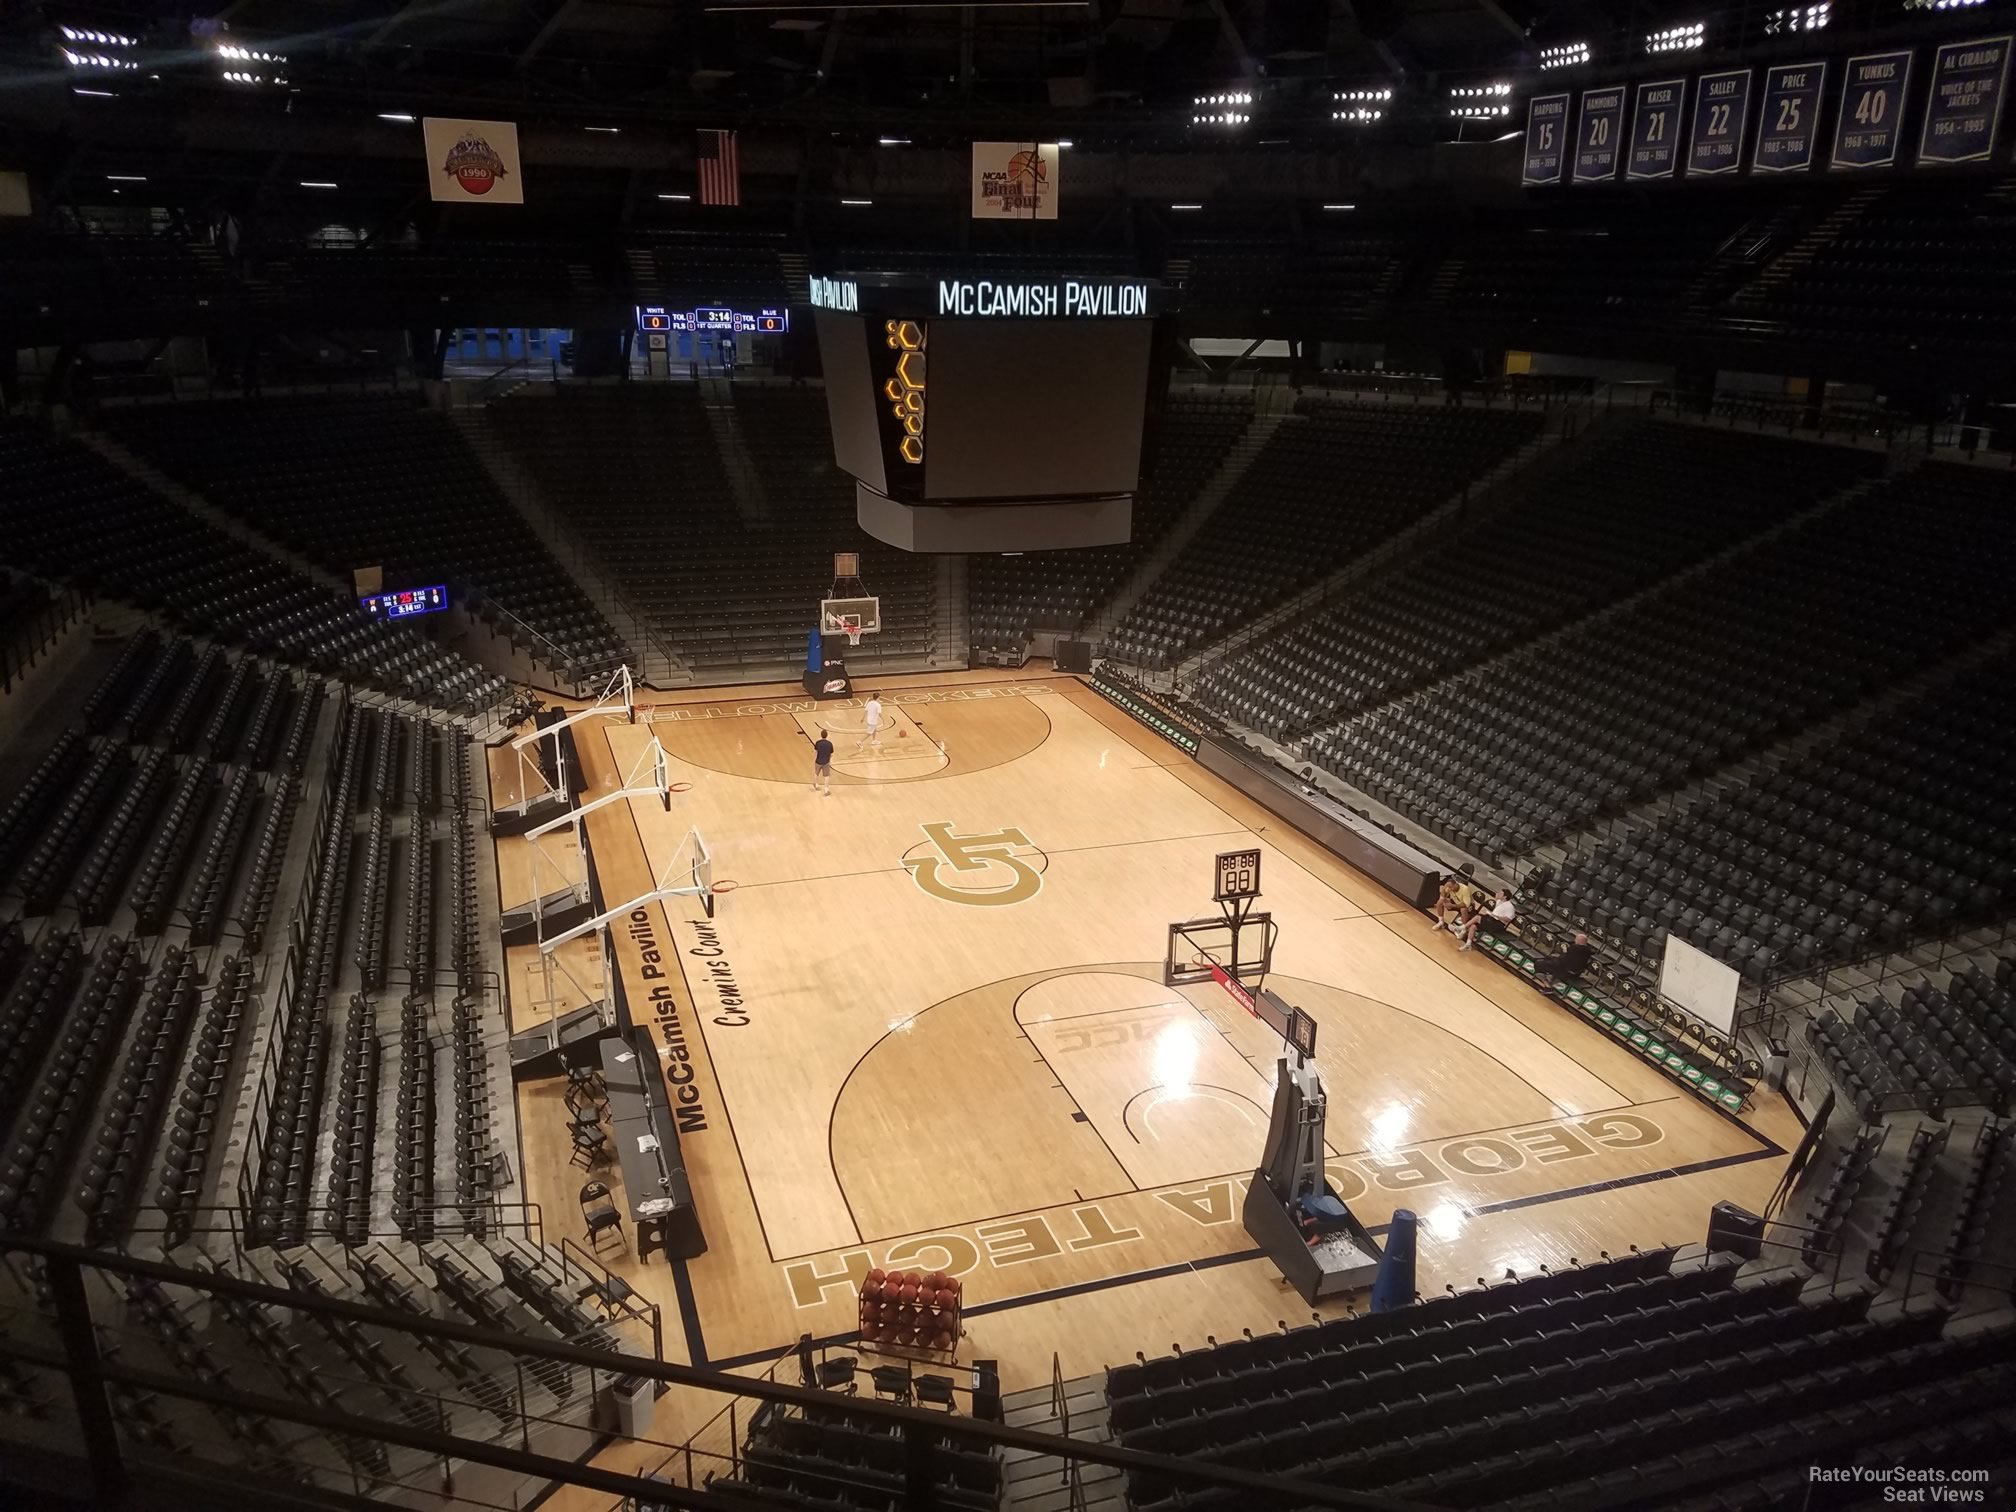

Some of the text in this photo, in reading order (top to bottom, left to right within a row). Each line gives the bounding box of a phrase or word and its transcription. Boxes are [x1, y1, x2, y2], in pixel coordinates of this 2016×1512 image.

[1859, 63, 1895, 80] YUNKUS
[1710, 81, 1736, 96] SALLEY
[1782, 74, 1806, 89] PRICE
[1647, 89, 1672, 103] KAISER
[1947, 94, 1980, 107] JACKETS
[1855, 89, 1886, 124] 40
[1707, 104, 1730, 136] 22
[1776, 98, 1801, 131] 25
[1589, 117, 1608, 146] 20
[1646, 112, 1665, 142] 21
[1539, 123, 1553, 150] 15
[463, 169, 487, 177] 1990
[982, 172, 1008, 180] NCAA
[982, 180, 1023, 198] Final
[1065, 281, 1147, 315] PAVILION
[652, 317, 660, 328] 0
[672, 313, 686, 321] TOL
[708, 312, 730, 322] 3:14
[742, 314, 756, 322] TOL
[766, 319, 774, 329] 0
[673, 322, 686, 330] FLS
[743, 323, 756, 331] FLS
[400, 593, 412, 604] 25
[604, 700, 818, 725] YELLOW
[684, 919, 751, 1027] Cremins Court
[628, 905, 708, 1134] McCamish Pavilio
[783, 1113, 1665, 1310] GEORA TECH
